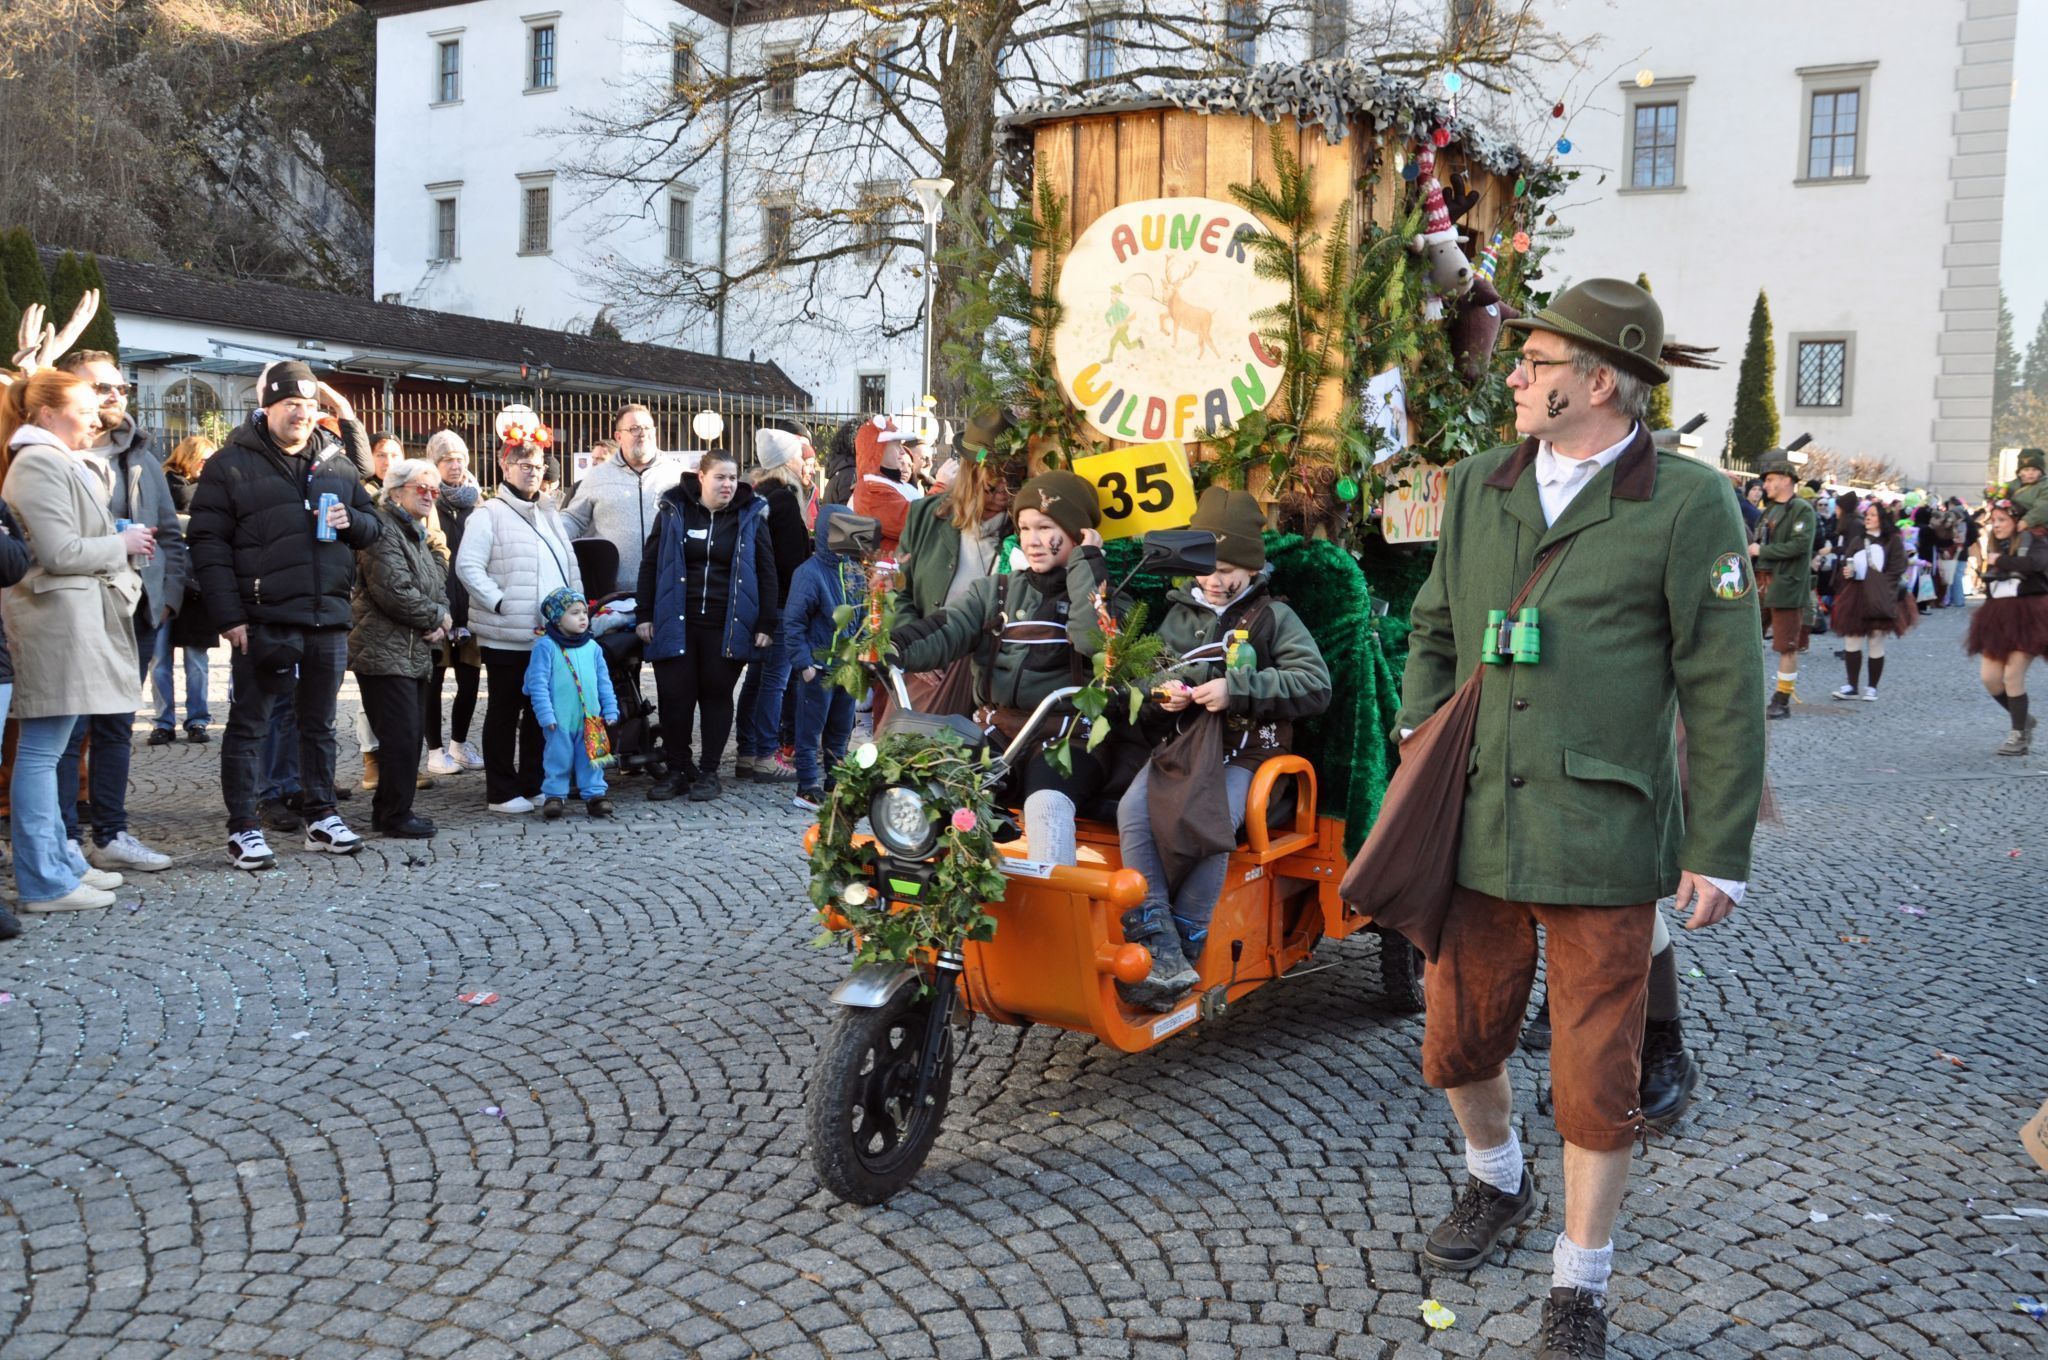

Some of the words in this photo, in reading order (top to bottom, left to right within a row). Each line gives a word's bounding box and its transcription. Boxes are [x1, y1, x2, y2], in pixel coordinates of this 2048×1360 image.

[1111, 213, 1258, 264] AUNER
[1072, 331, 1283, 439] WILDFANG
[1097, 462, 1174, 520] 35
